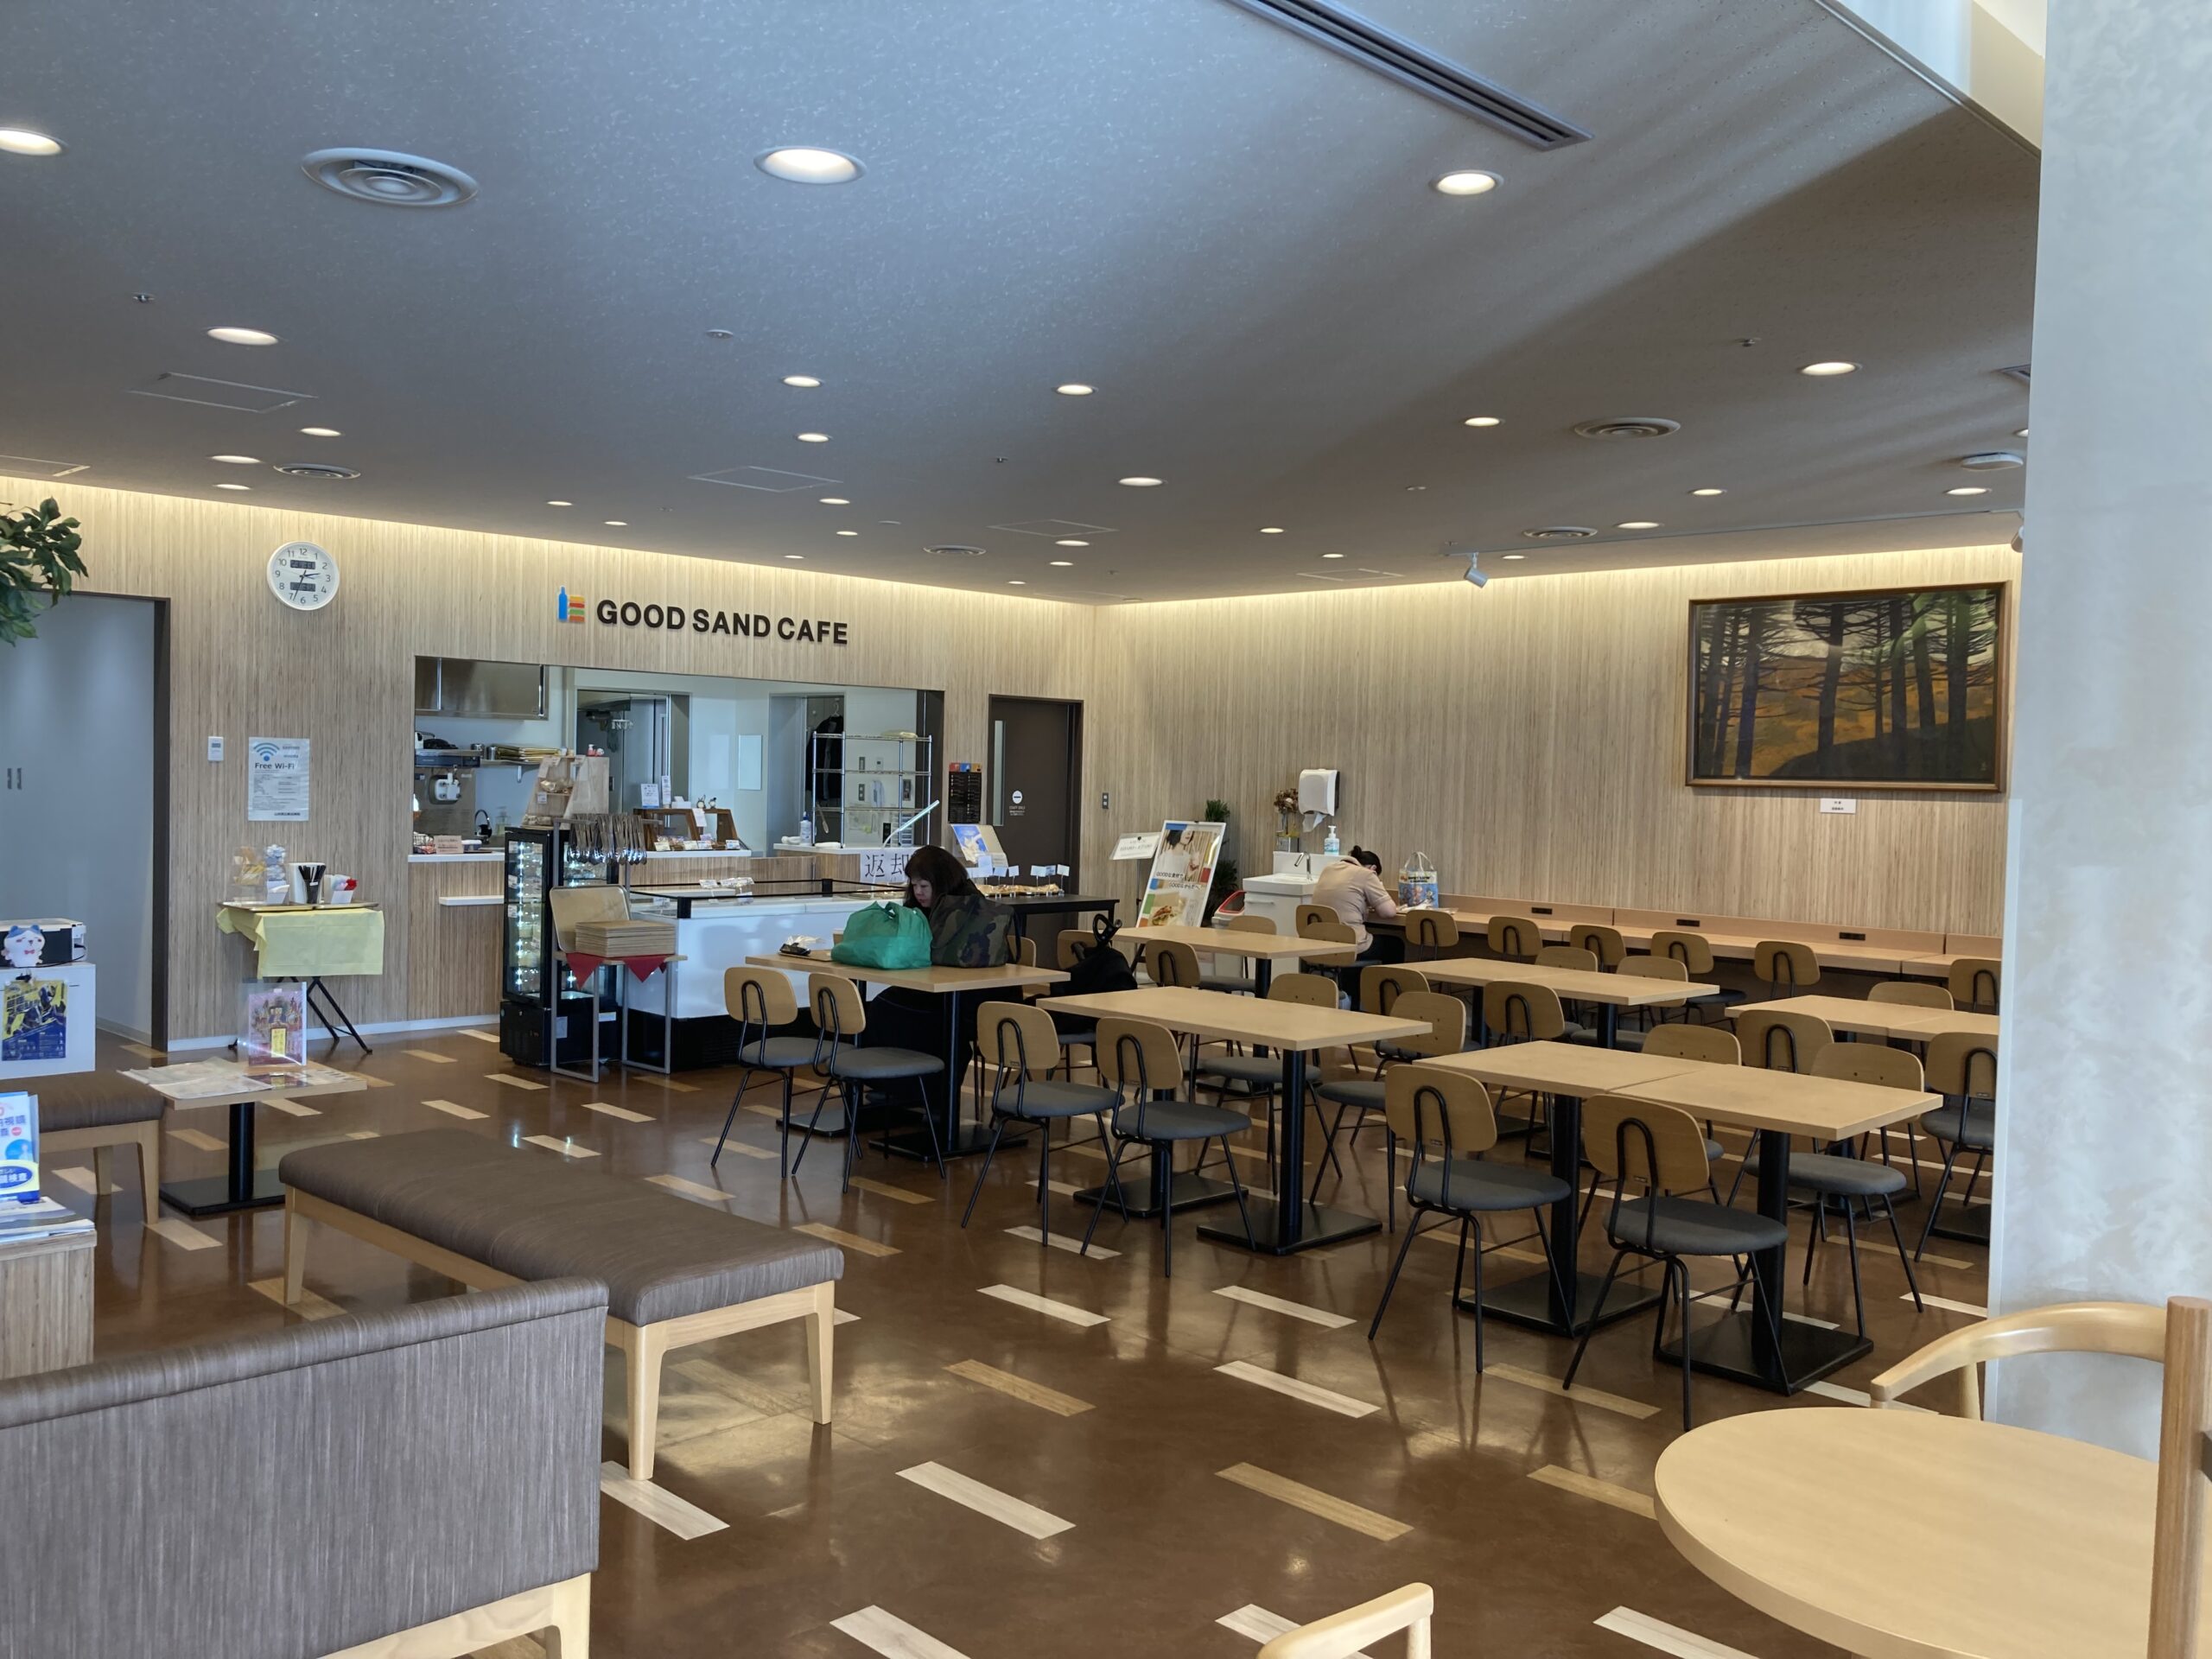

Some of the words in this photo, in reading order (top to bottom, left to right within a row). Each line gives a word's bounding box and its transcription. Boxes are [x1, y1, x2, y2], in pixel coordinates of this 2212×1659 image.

[596, 599, 686, 630] GOOD
[692, 608, 771, 638] SAND
[777, 617, 849, 645] CAFE
[864, 854, 909, 878] 返却
